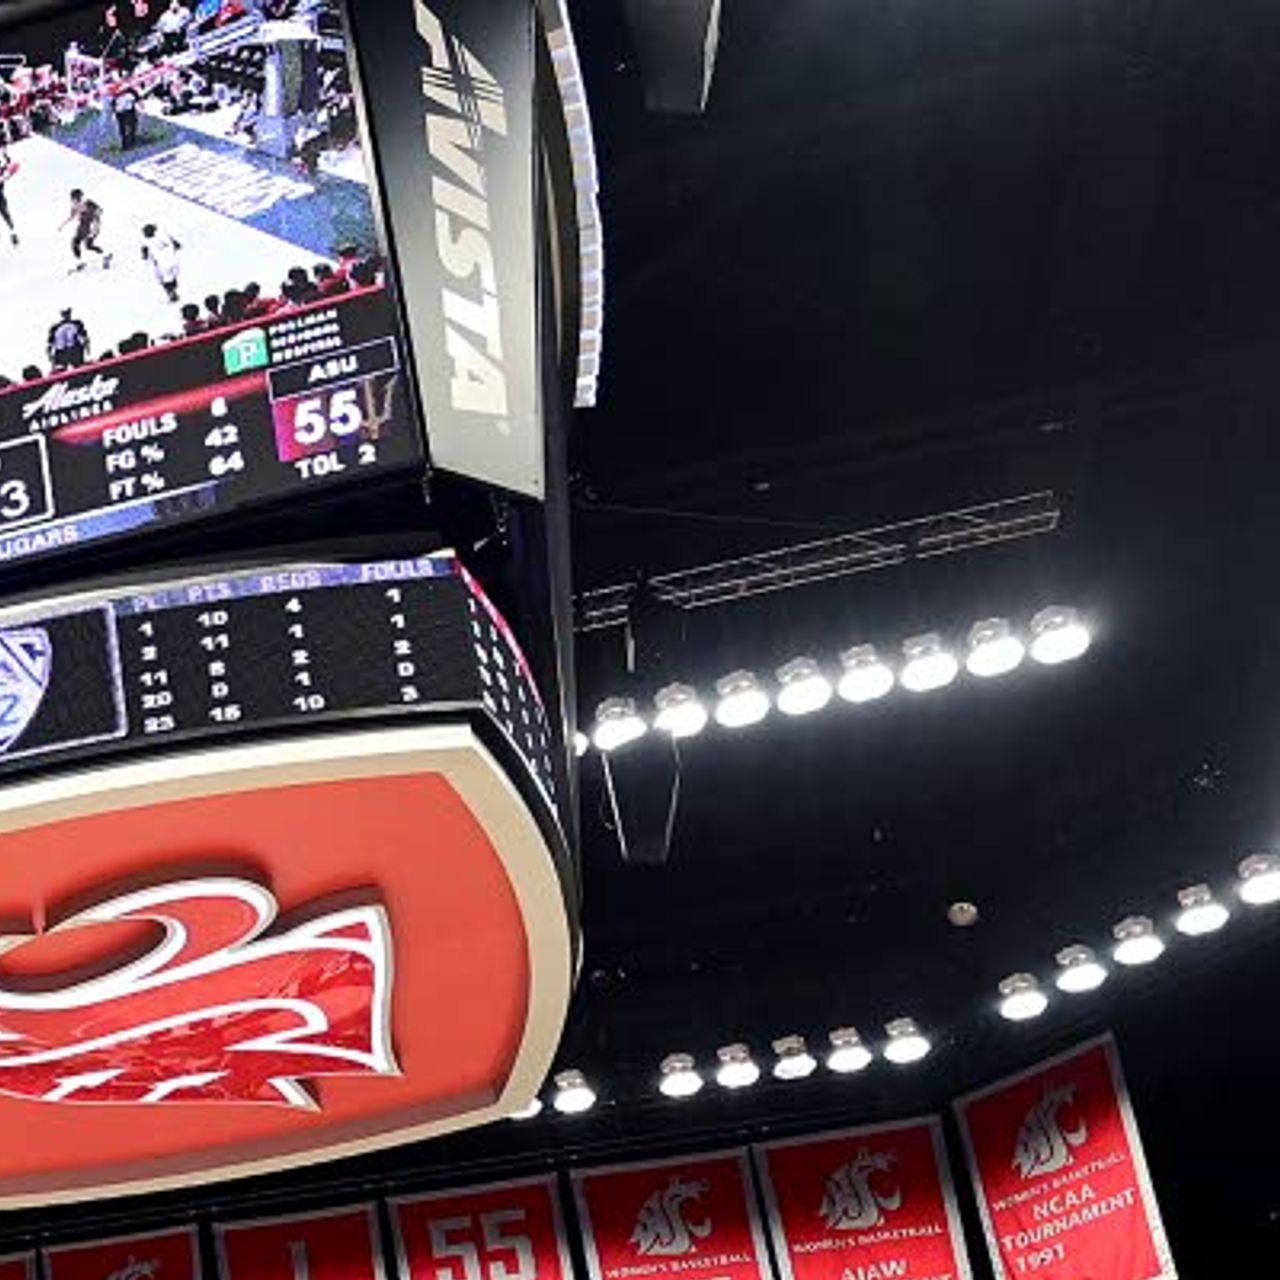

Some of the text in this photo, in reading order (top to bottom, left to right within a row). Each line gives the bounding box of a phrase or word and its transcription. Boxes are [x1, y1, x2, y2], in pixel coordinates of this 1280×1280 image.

[308, 355, 358, 382] ASU
[102, 412, 178, 449] FOULS
[294, 390, 363, 443] 55
[106, 425, 239, 473] FG % 42
[295, 443, 376, 478] TOL 2
[109, 477, 136, 501] FT
[140, 471, 165, 492] %
[361, 558, 433, 582] FOULS
[138, 621, 154, 638] 1
[197, 610, 228, 628] 10
[385, 588, 401, 603] 1
[200, 633, 229, 651] 11
[289, 623, 304, 639] 1
[391, 613, 405, 629] 1
[140, 670, 168, 688] 11
[394, 640, 412, 655] 2
[295, 672, 311, 687] 1
[293, 694, 325, 712] 10
[1001, 1189, 1137, 1253] TOURNAMENT
[1033, 1184, 1097, 1221] NCAA
[1016, 1242, 1067, 1274] 1991
